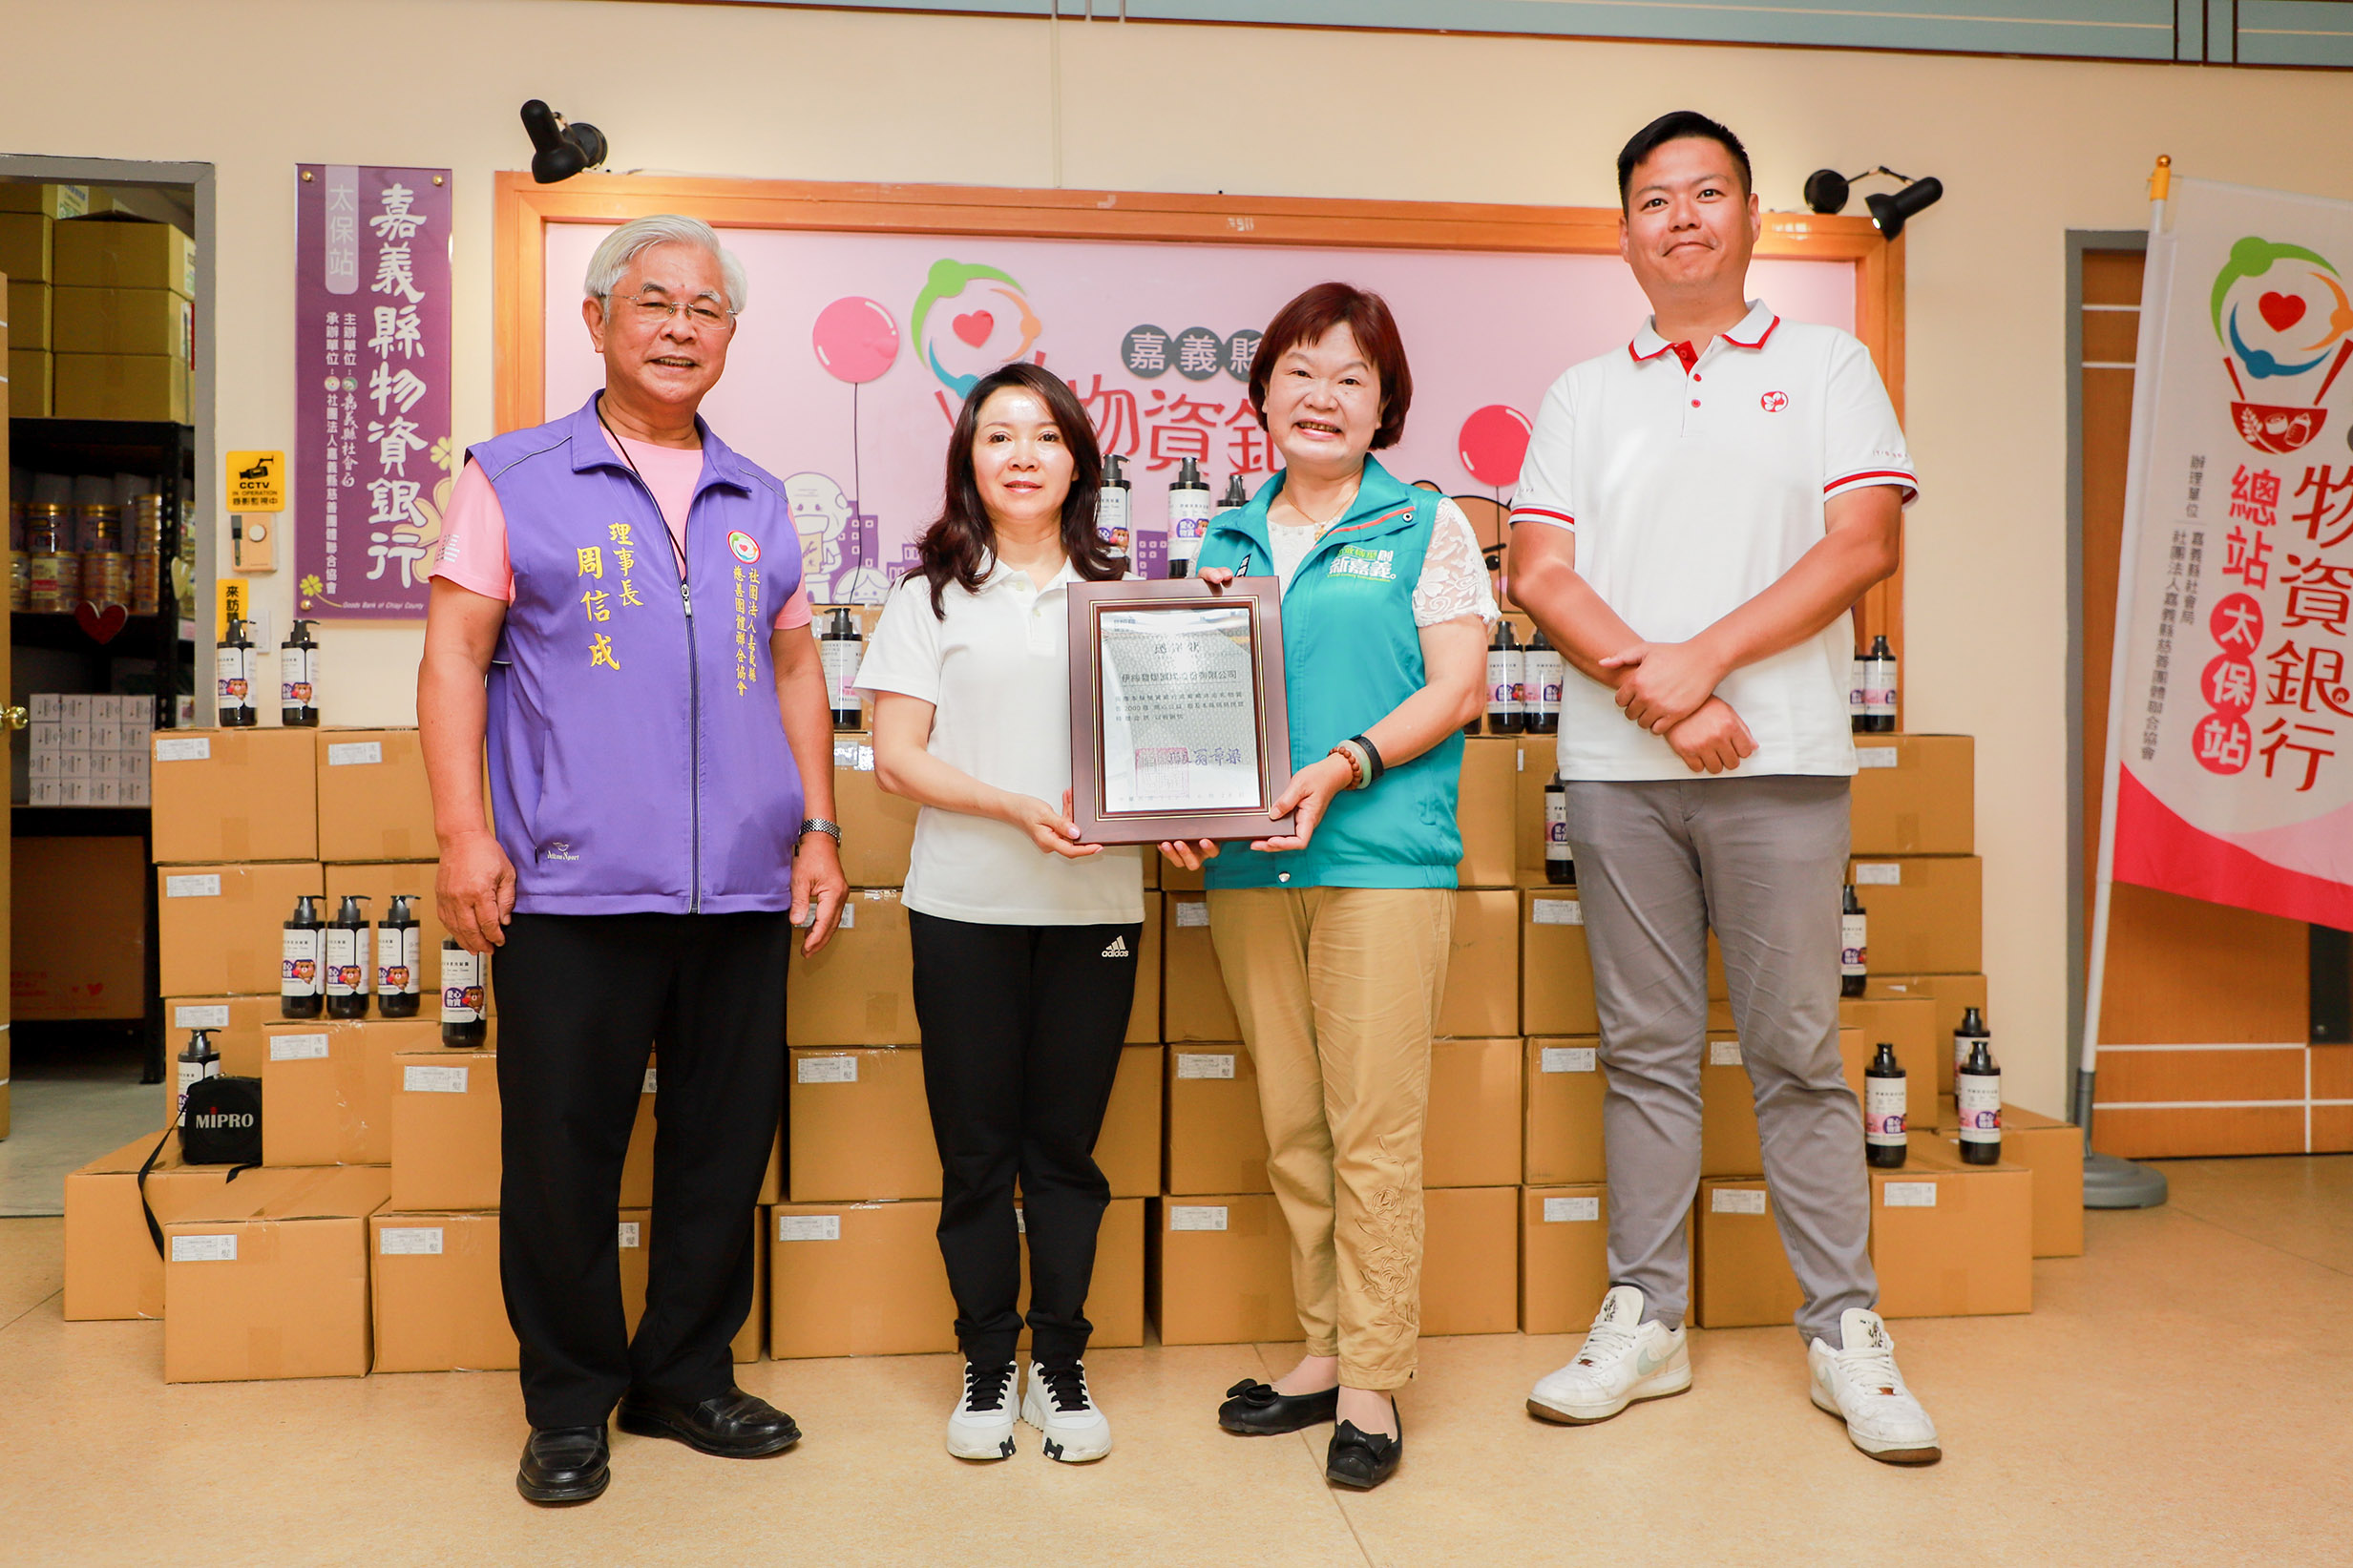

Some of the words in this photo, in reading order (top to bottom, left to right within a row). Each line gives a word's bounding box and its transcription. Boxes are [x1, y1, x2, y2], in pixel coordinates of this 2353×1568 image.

[329, 182, 354, 278] 太保站
[366, 182, 428, 589] 嘉義縣物資銀行
[608, 522, 643, 608] 理事長
[2222, 463, 2281, 591] 總站
[576, 546, 620, 671] 周信成
[2258, 464, 2353, 792] 物資銀行
[2200, 601, 2258, 768] 太保站
[1101, 949, 1129, 958] adidas
